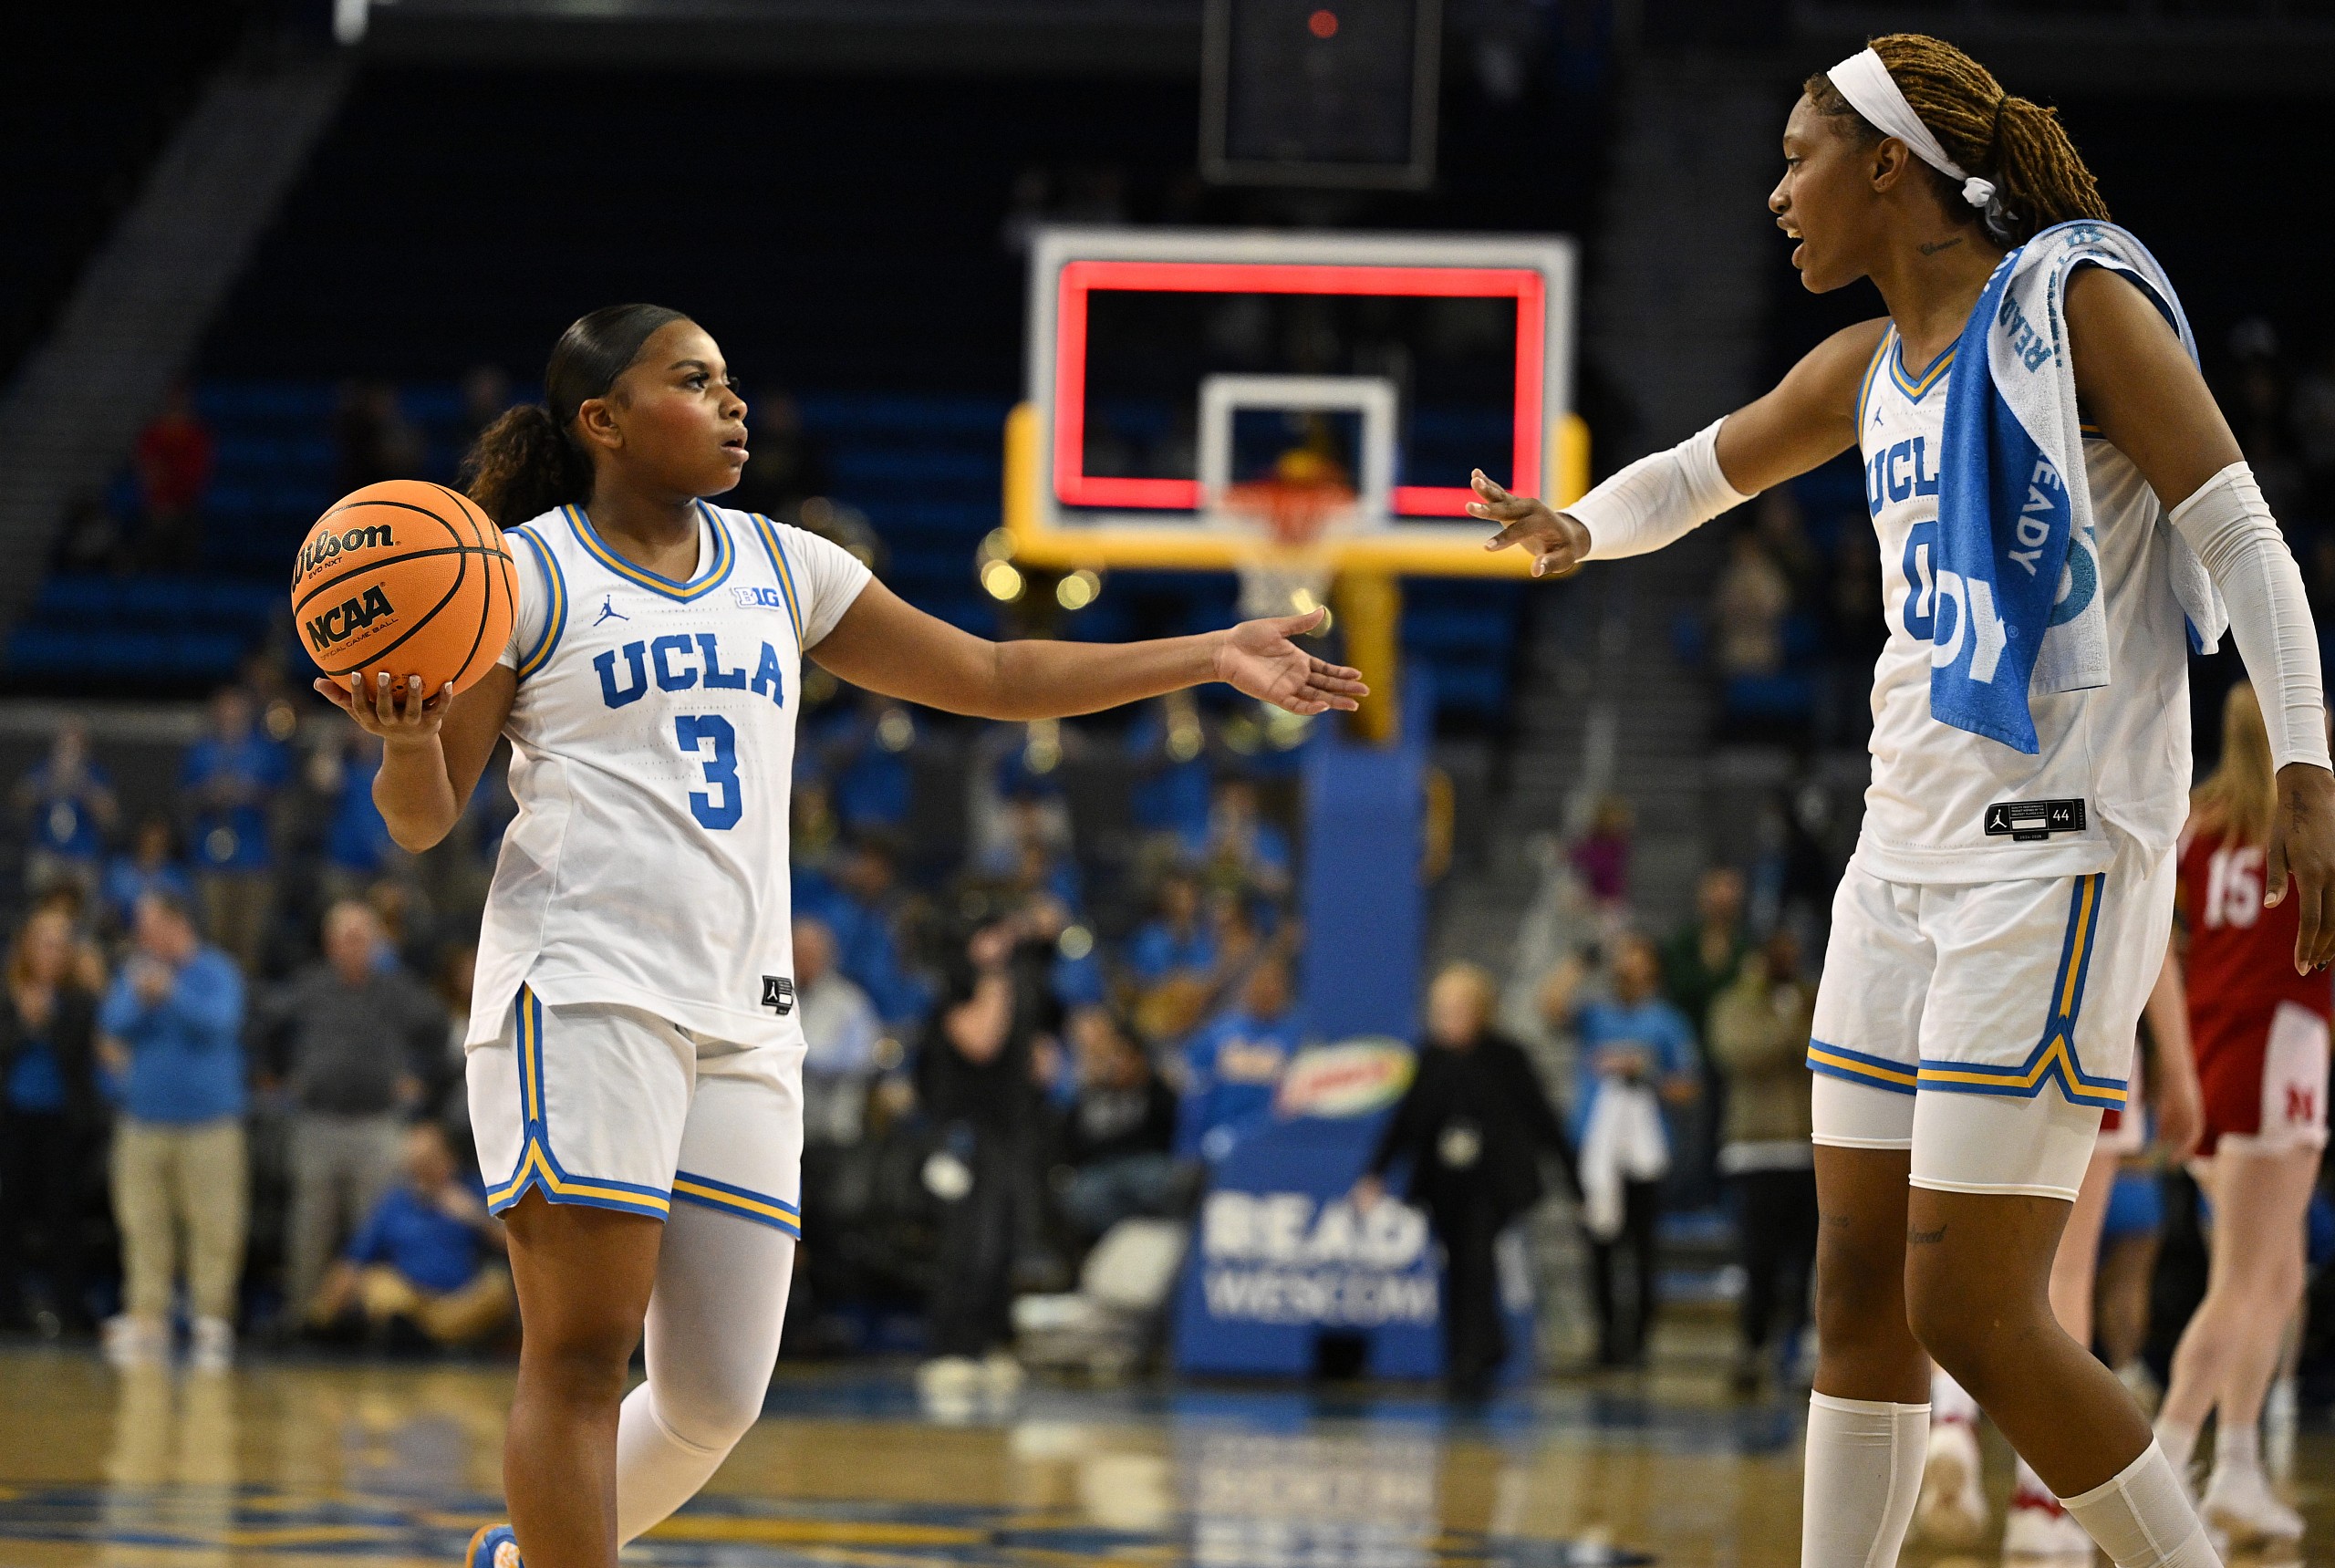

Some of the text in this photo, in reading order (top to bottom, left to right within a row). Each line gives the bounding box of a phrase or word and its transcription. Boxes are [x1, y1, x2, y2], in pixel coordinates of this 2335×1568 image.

[1866, 436, 1939, 519] UCL
[2008, 451, 2061, 576] EADY
[292, 524, 394, 594] Wilson
[308, 556, 343, 580] EVO NXT
[306, 584, 395, 653] NCAA
[346, 630, 372, 648] GAME
[371, 618, 400, 634] BALL
[593, 633, 784, 710] UCLA
[675, 714, 742, 830] 3
[2052, 808, 2070, 822] 44
[2205, 847, 2262, 929] 15
